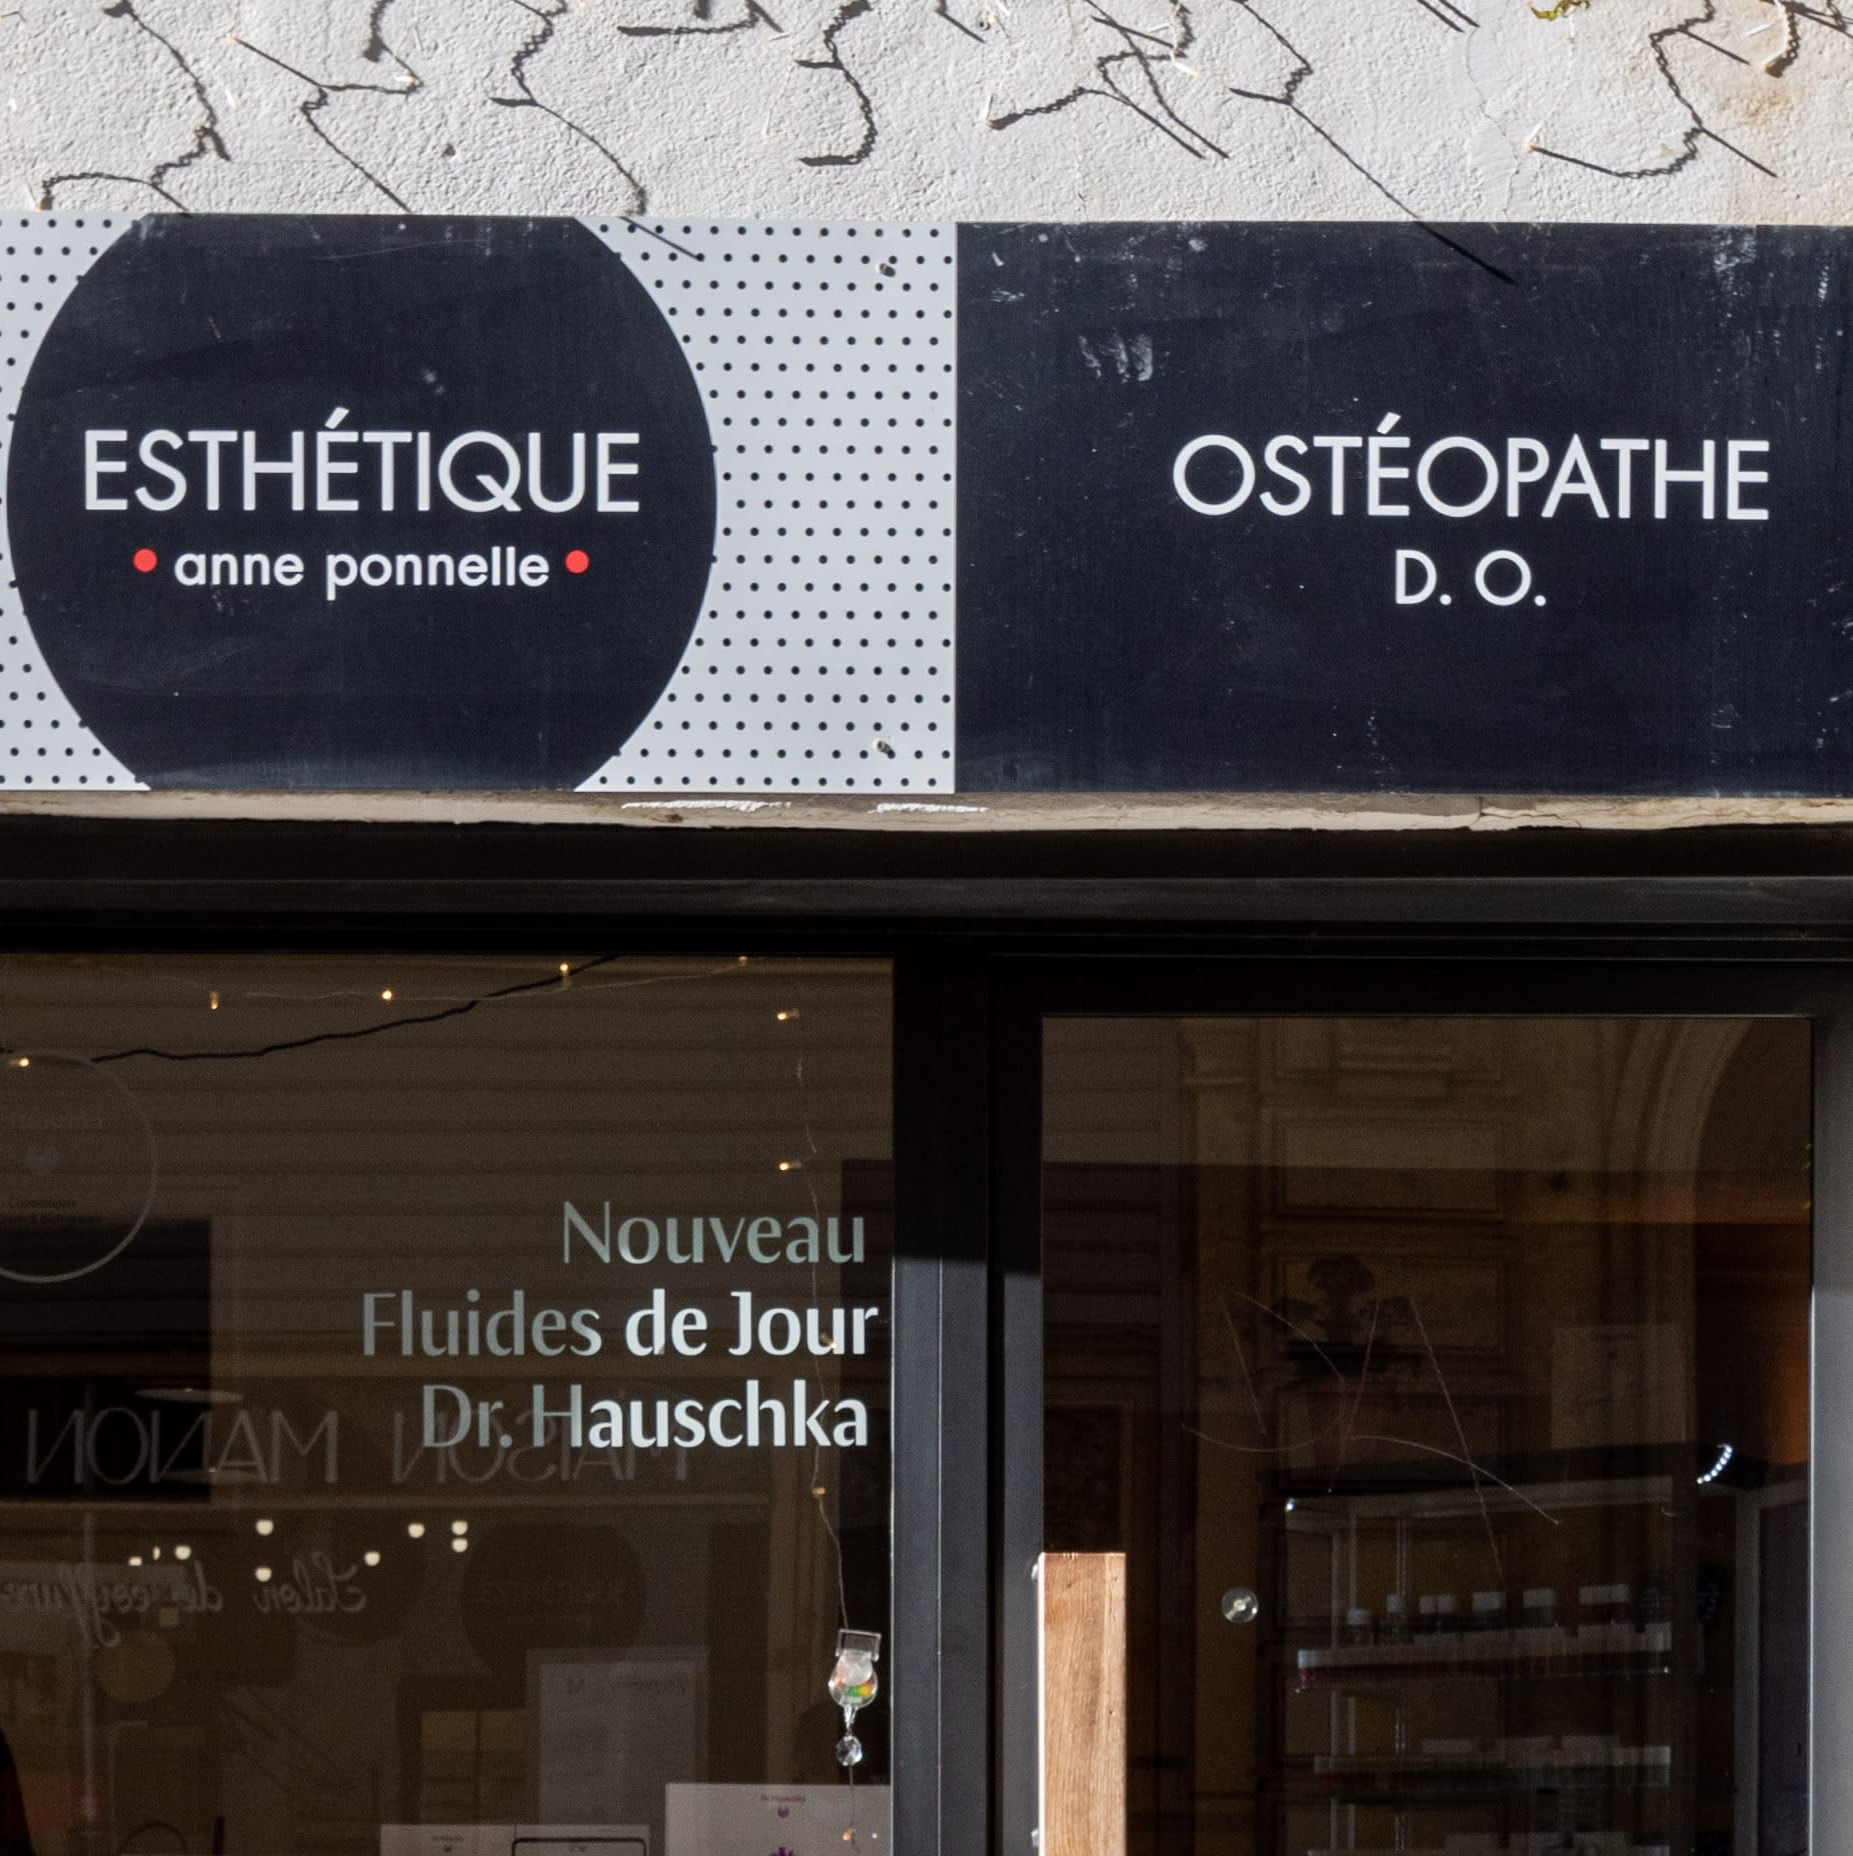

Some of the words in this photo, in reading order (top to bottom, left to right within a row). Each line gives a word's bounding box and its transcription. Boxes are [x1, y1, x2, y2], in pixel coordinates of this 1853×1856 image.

[84, 414, 640, 513] ESTHÉTIQUE
[1171, 424, 1771, 522] OSTÉOPATHE
[174, 552, 304, 587] anne
[325, 546, 551, 601] ponnelle
[1394, 549, 1453, 608] D.
[1473, 549, 1547, 608] O.
[563, 1201, 865, 1266] Nouveau
[364, 1288, 603, 1357] Fluides
[624, 1288, 708, 1357] de
[728, 1290, 879, 1358] Jour
[423, 1382, 513, 1449] Dr.
[532, 1379, 868, 1449] Hauschka
